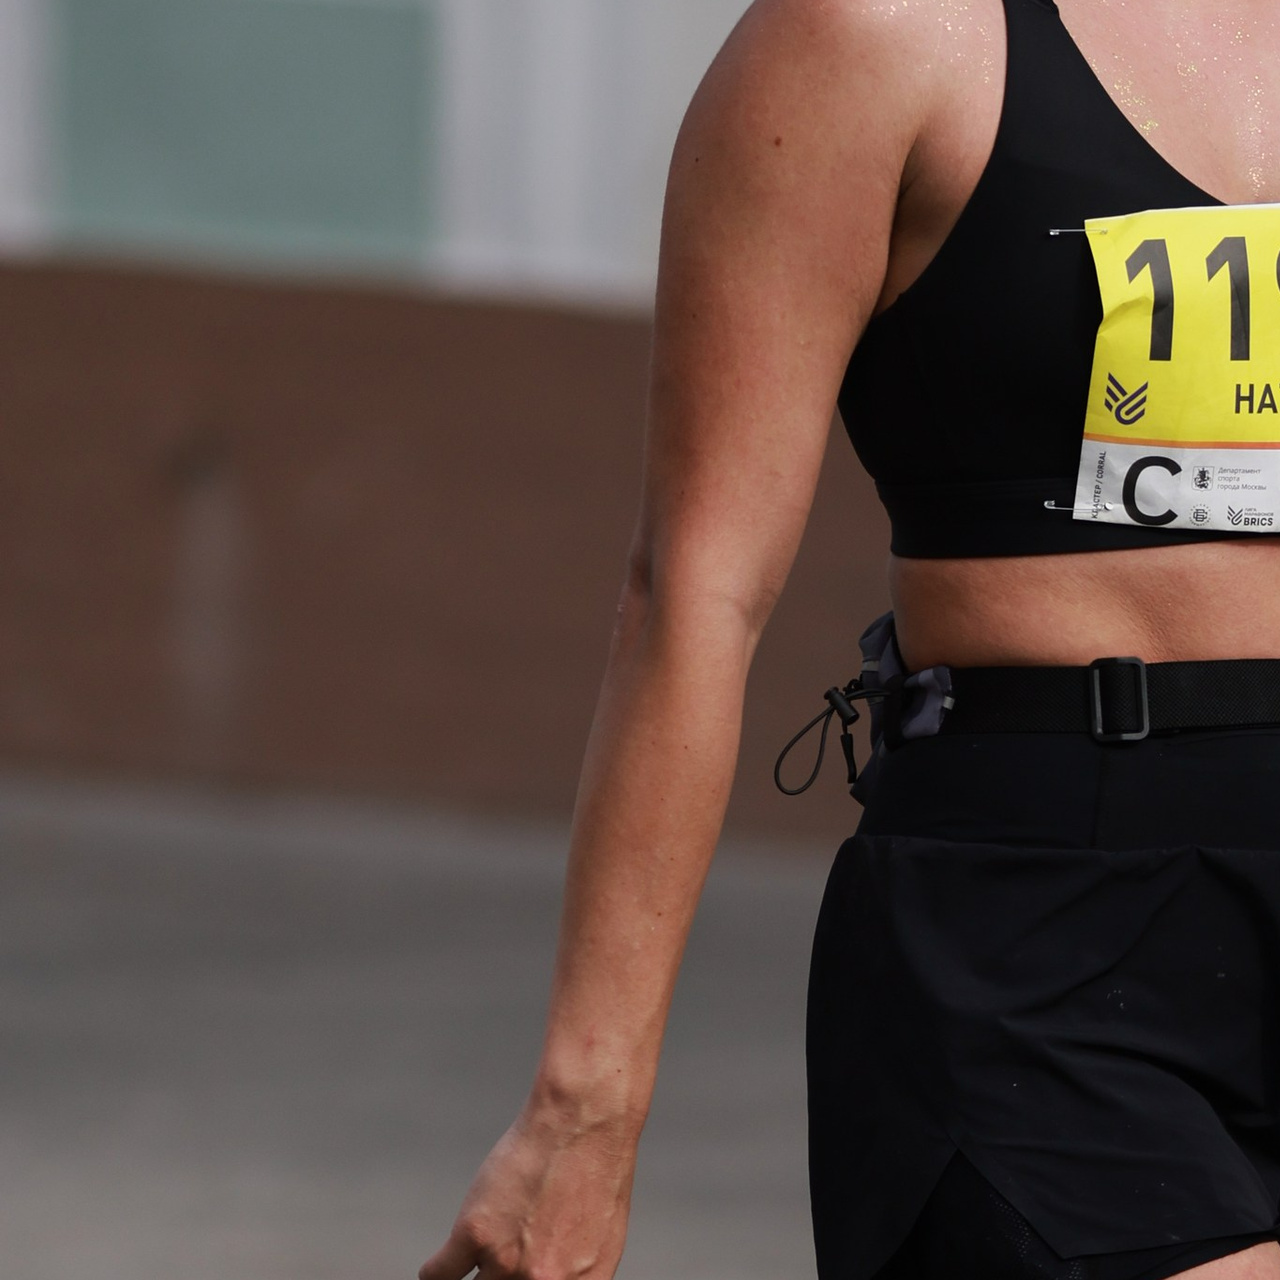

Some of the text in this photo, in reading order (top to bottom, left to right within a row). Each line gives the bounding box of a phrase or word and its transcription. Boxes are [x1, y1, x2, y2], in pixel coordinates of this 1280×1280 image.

[1096, 451, 1107, 479] CORRAL
[1217, 466, 1262, 475] Департамент
[1243, 517, 1274, 527] BRICS
